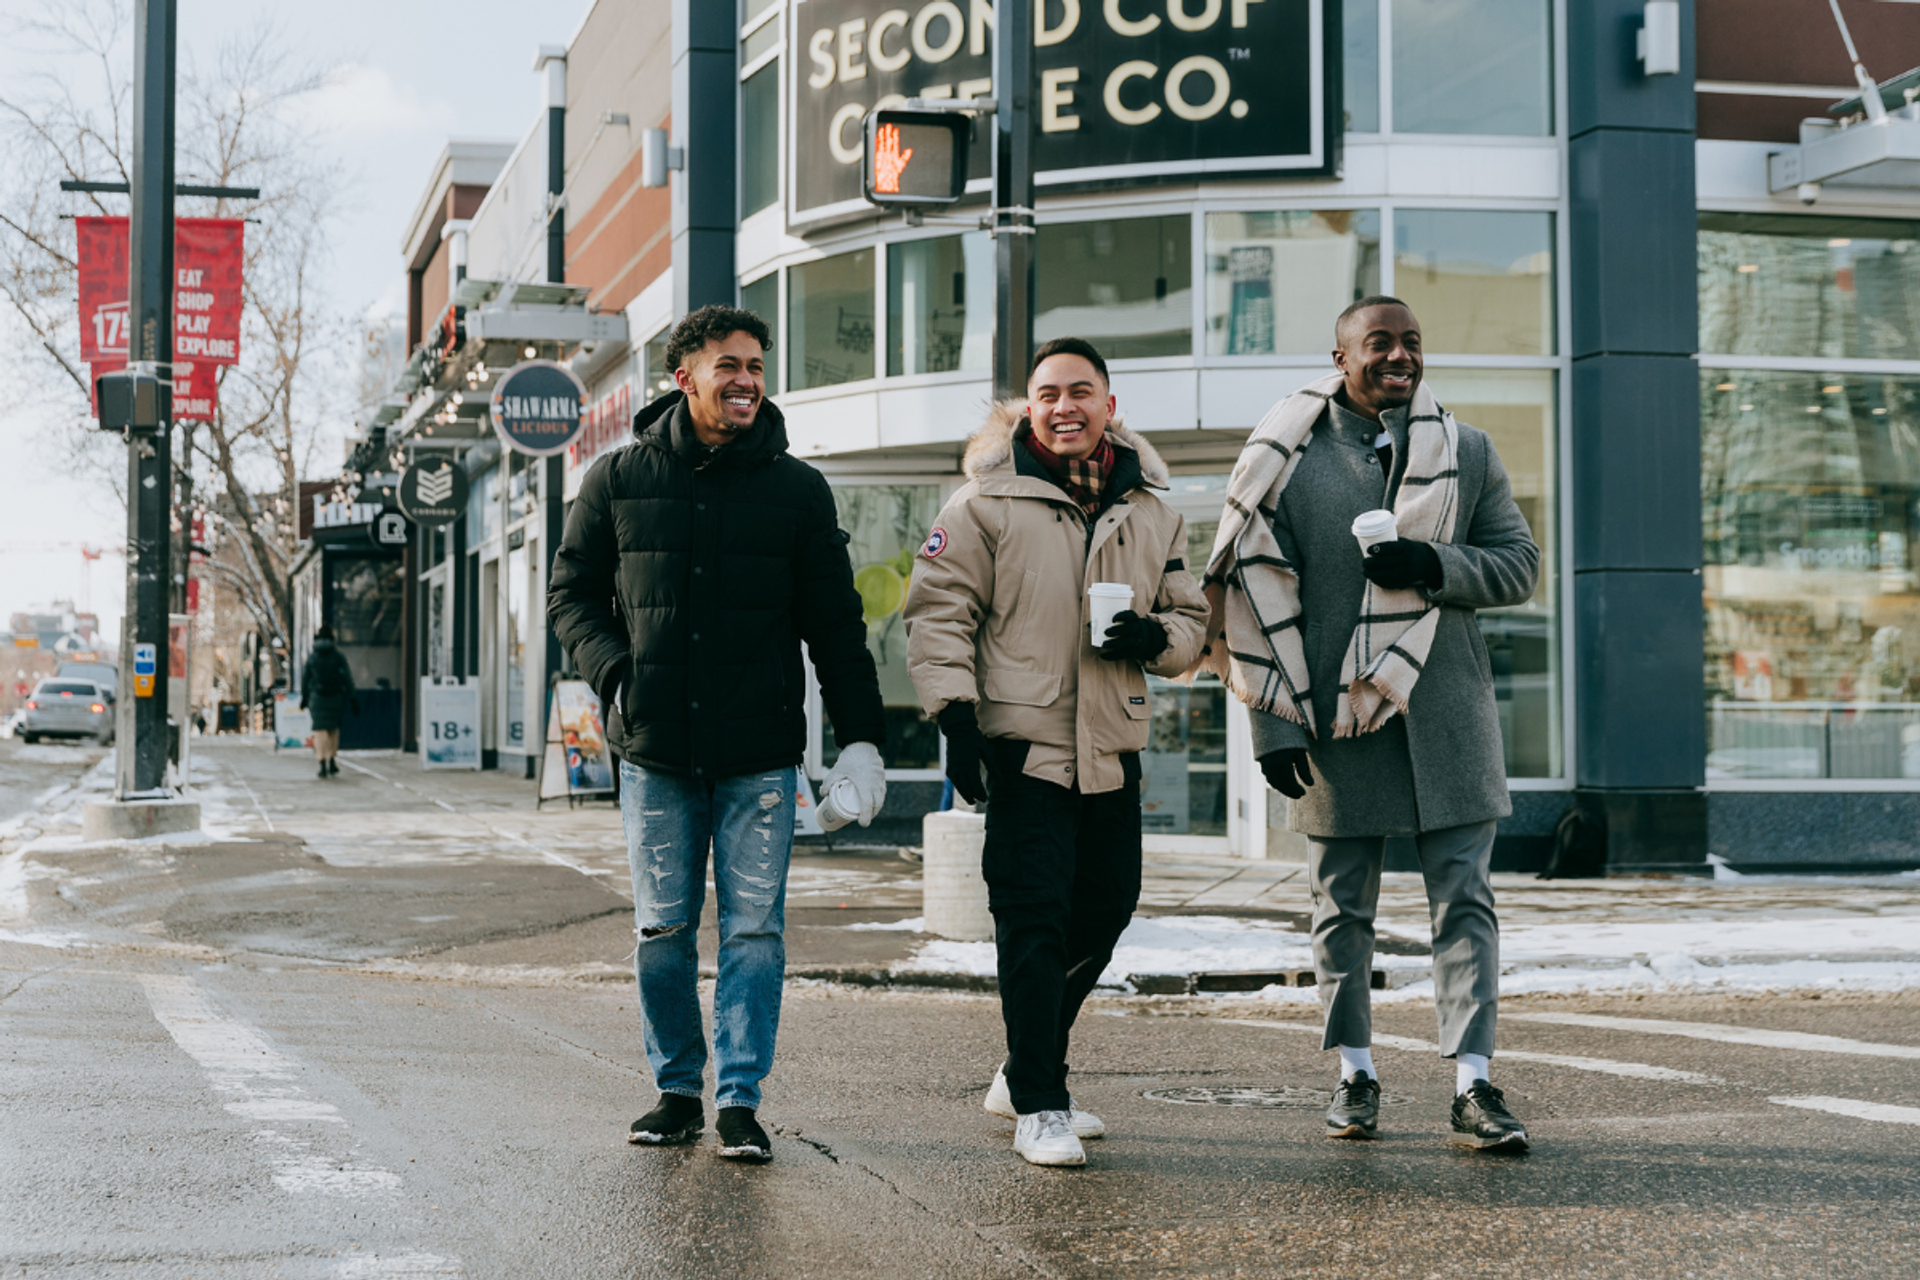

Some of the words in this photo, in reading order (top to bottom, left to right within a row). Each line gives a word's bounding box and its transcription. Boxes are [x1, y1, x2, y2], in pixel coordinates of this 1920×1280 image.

[1103, 55, 1249, 126] CO.
[177, 269, 204, 288] EAT
[177, 291, 214, 311] SHOP
[176, 313, 211, 334] PLAY
[177, 336, 236, 358] EXPLORE
[172, 361, 194, 377] HOP
[172, 379, 191, 396] LAY
[172, 398, 212, 415] XPLORE
[504, 395, 579, 420] SHAWARMA
[512, 421, 569, 435] LICIOUS
[430, 721, 473, 741] 18+
